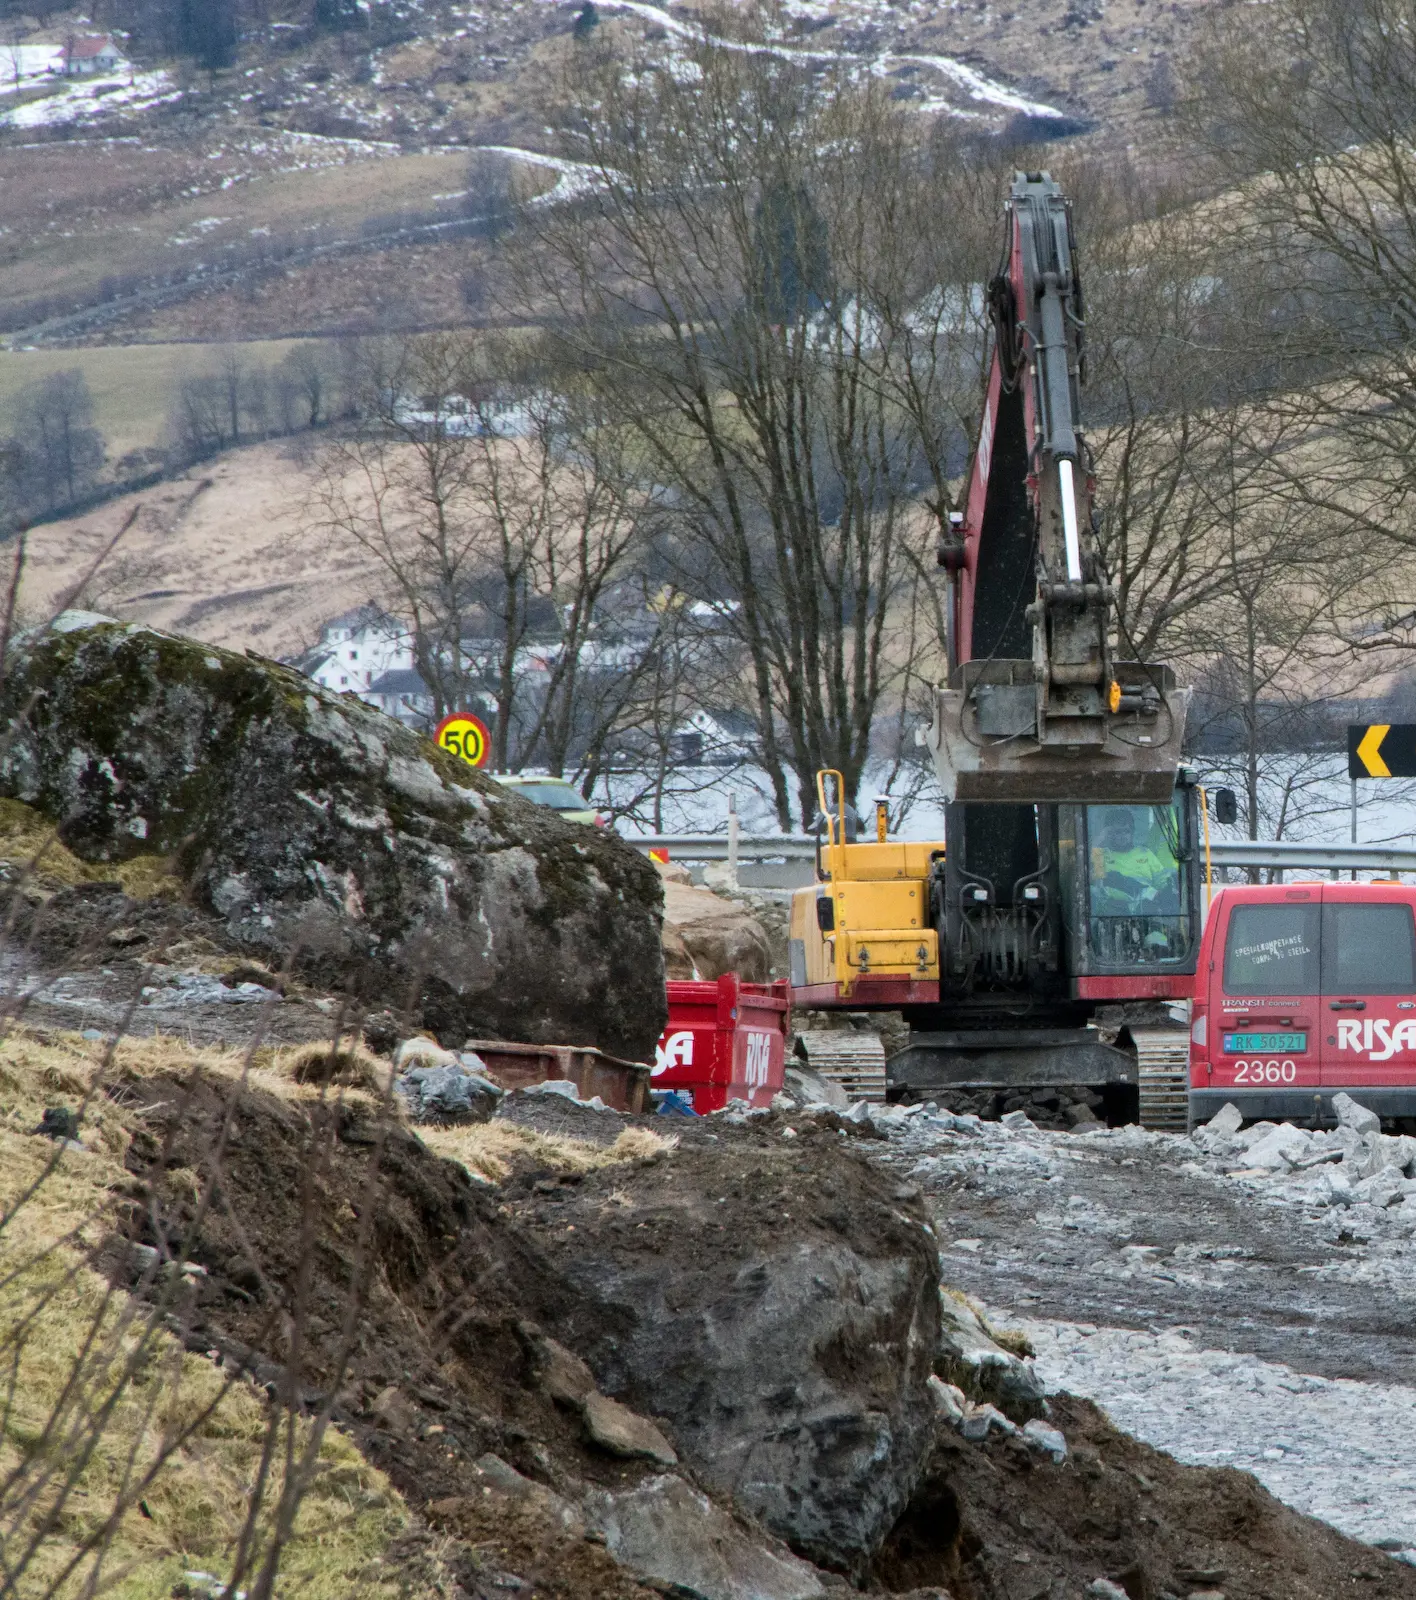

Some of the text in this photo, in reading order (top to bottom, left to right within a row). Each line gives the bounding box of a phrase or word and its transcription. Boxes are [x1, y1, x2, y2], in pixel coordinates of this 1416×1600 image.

[445, 730, 479, 759] 50
[650, 1031, 694, 1077] SA
[1236, 1036, 1303, 1049] RK 50521
[1234, 1060, 1296, 1083] 2360
